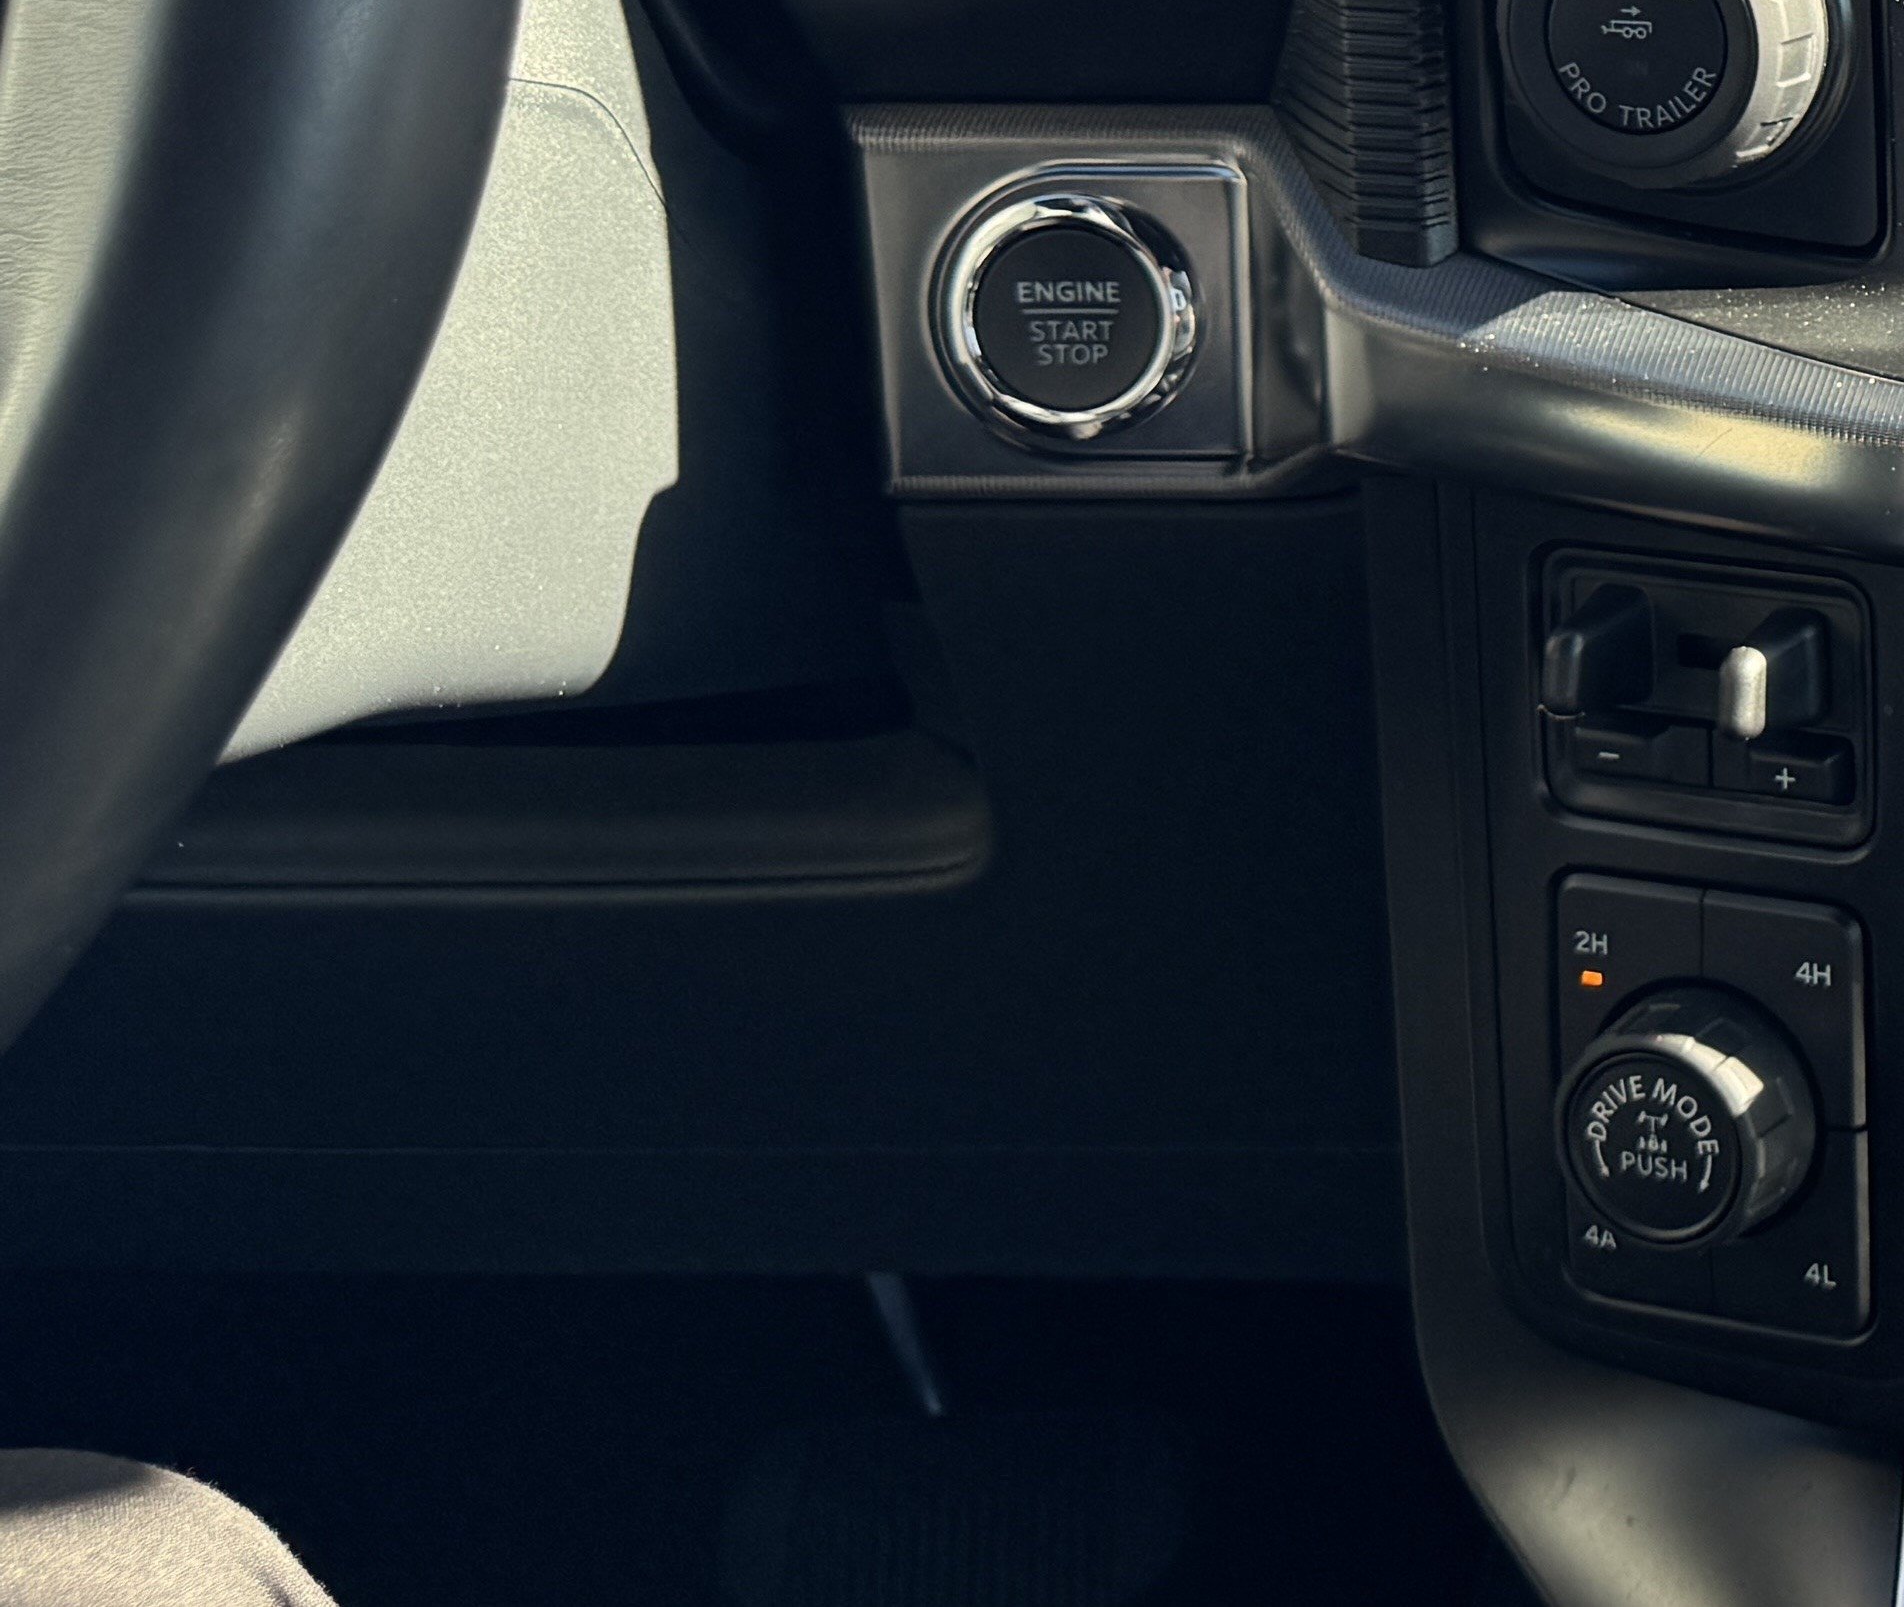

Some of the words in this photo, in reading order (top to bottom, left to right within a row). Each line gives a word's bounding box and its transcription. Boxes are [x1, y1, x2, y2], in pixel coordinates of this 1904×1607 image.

[1558, 62, 1607, 114] PRO
[1620, 66, 1717, 128] TRAILER
[1017, 281, 1121, 303] ENGINE
[1031, 320, 1114, 342] START
[1038, 343, 1108, 365] STOP
[1574, 931, 1608, 956] 2H
[1795, 961, 1831, 987] 4H
[1586, 1074, 1646, 1142] DRIVE
[1651, 1077, 1720, 1156] MODE
[1620, 1149, 1688, 1182] PUSH
[1585, 1225, 1617, 1250] 4A
[1804, 1262, 1836, 1288] 4L
